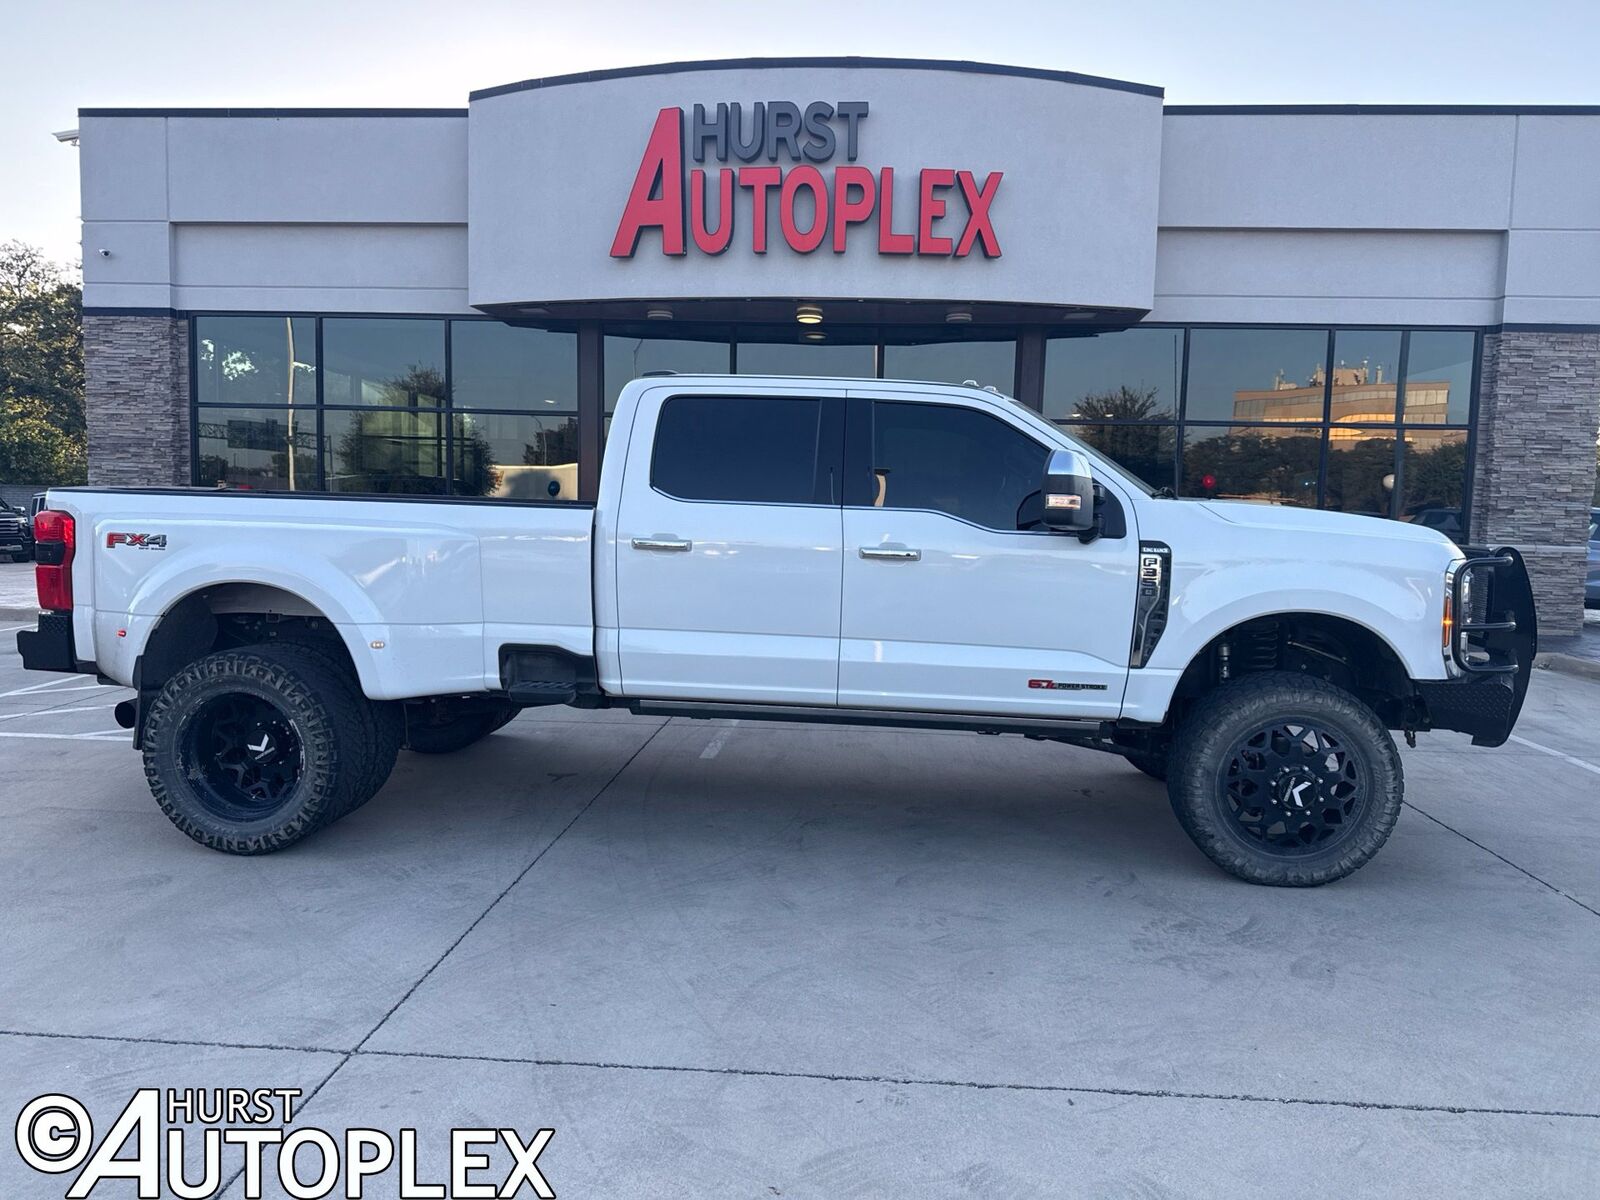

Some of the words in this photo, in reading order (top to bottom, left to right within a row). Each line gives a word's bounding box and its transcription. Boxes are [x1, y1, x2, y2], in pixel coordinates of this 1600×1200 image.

[692, 100, 869, 163] HURST
[609, 106, 1004, 258] AUTOPLEX
[106, 532, 167, 548] FX4
